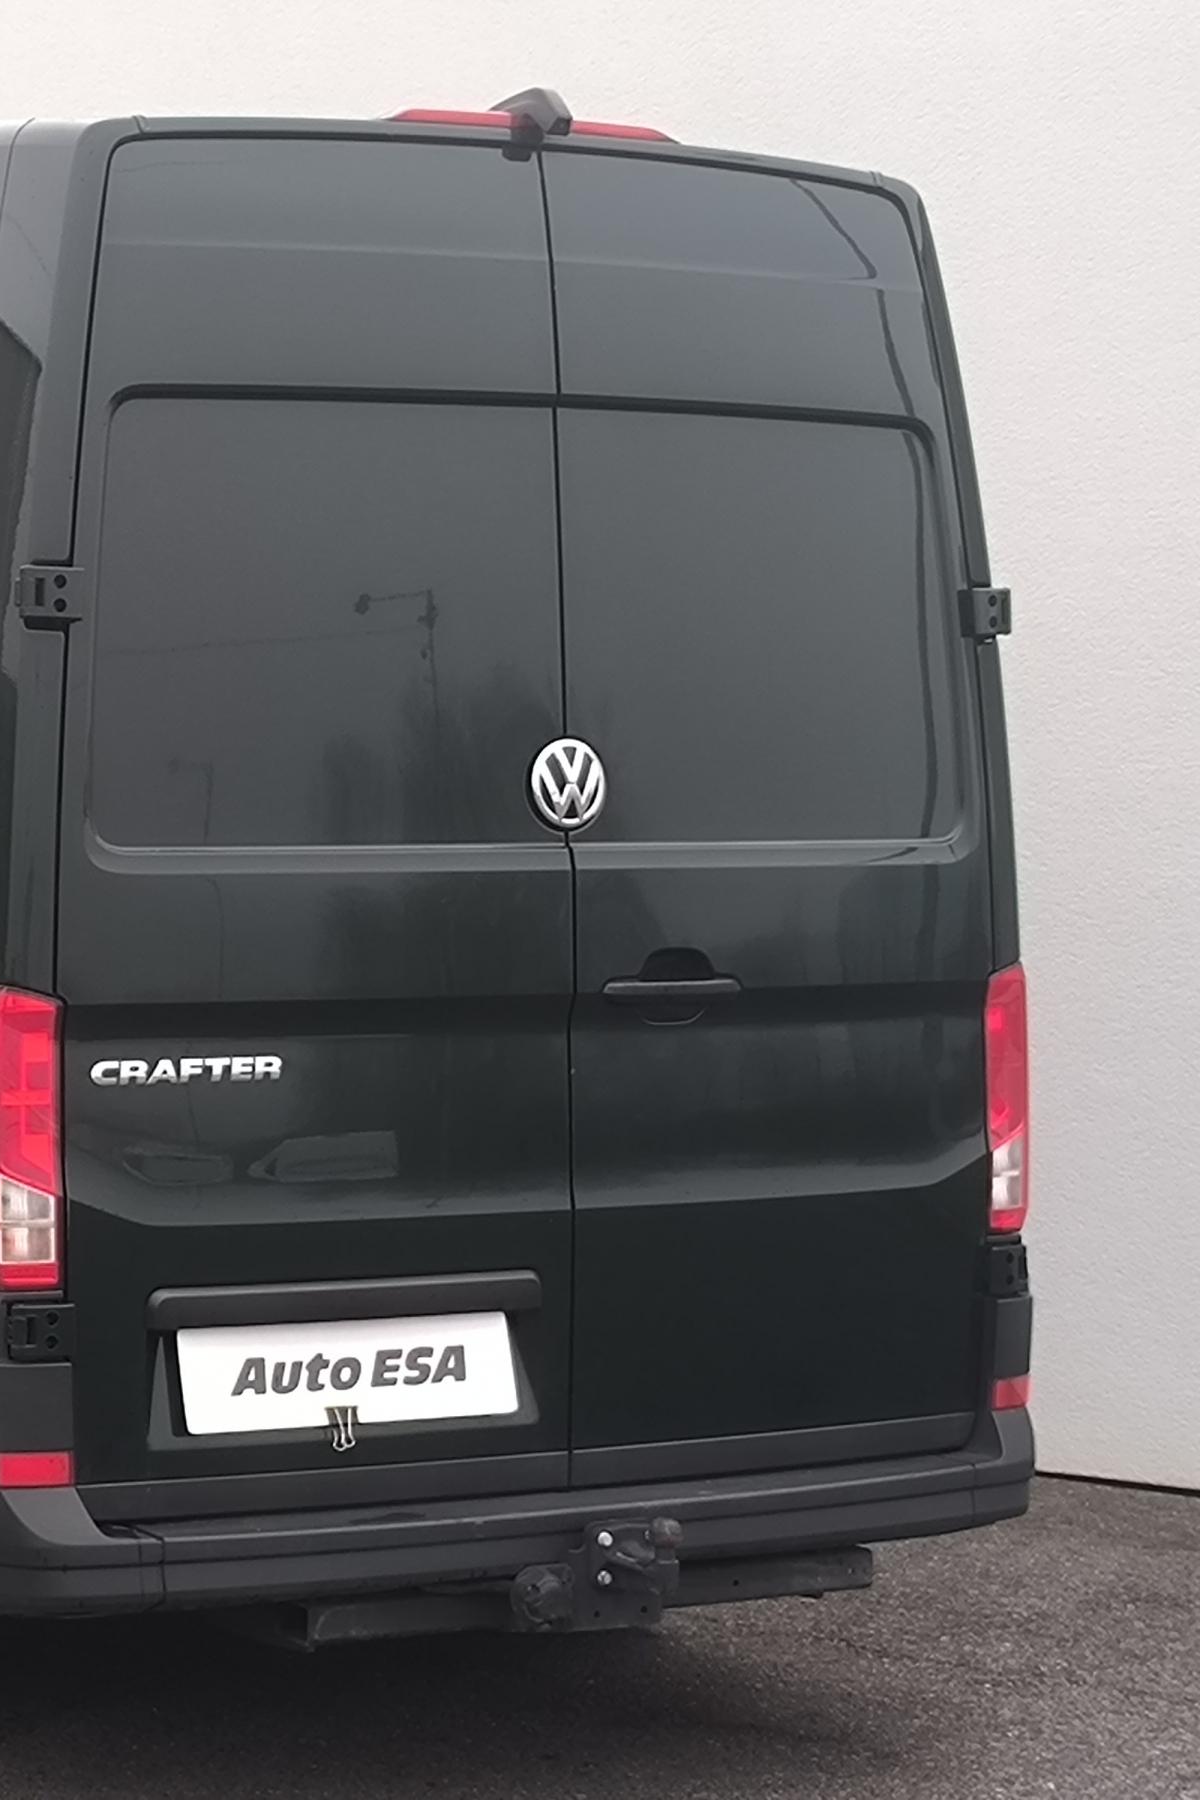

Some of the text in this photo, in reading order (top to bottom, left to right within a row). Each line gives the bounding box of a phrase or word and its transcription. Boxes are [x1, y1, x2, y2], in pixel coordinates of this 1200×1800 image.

[532, 739, 604, 826] VW
[90, 1055, 283, 1086] CRAFTER
[231, 1345, 467, 1396] Auto ESA
